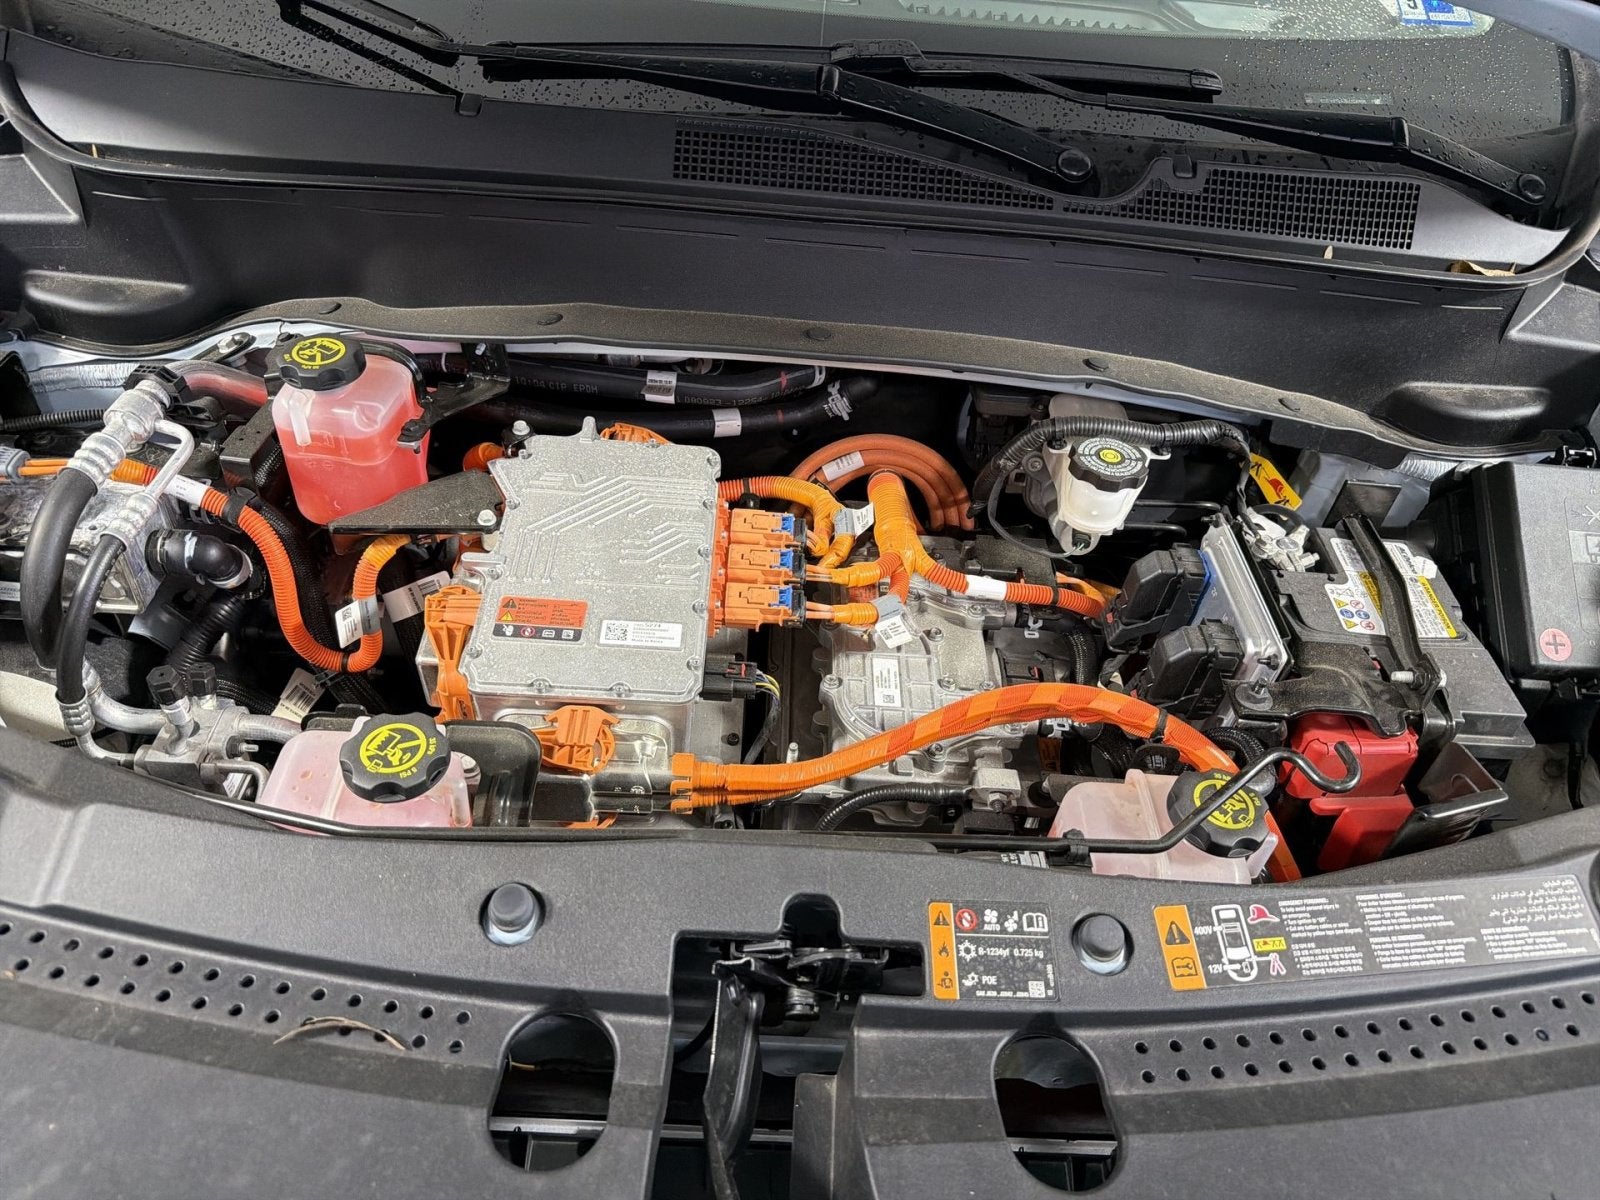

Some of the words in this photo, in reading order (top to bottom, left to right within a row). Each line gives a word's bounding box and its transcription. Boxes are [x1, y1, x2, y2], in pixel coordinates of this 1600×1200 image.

[1194, 926, 1212, 935] 400V
[978, 947, 1010, 958] R-1234yf
[1013, 948, 1033, 957] 0.725
[1034, 948, 1044, 959] kg
[1208, 964, 1222, 974] 12V
[982, 976, 997, 985] POE
